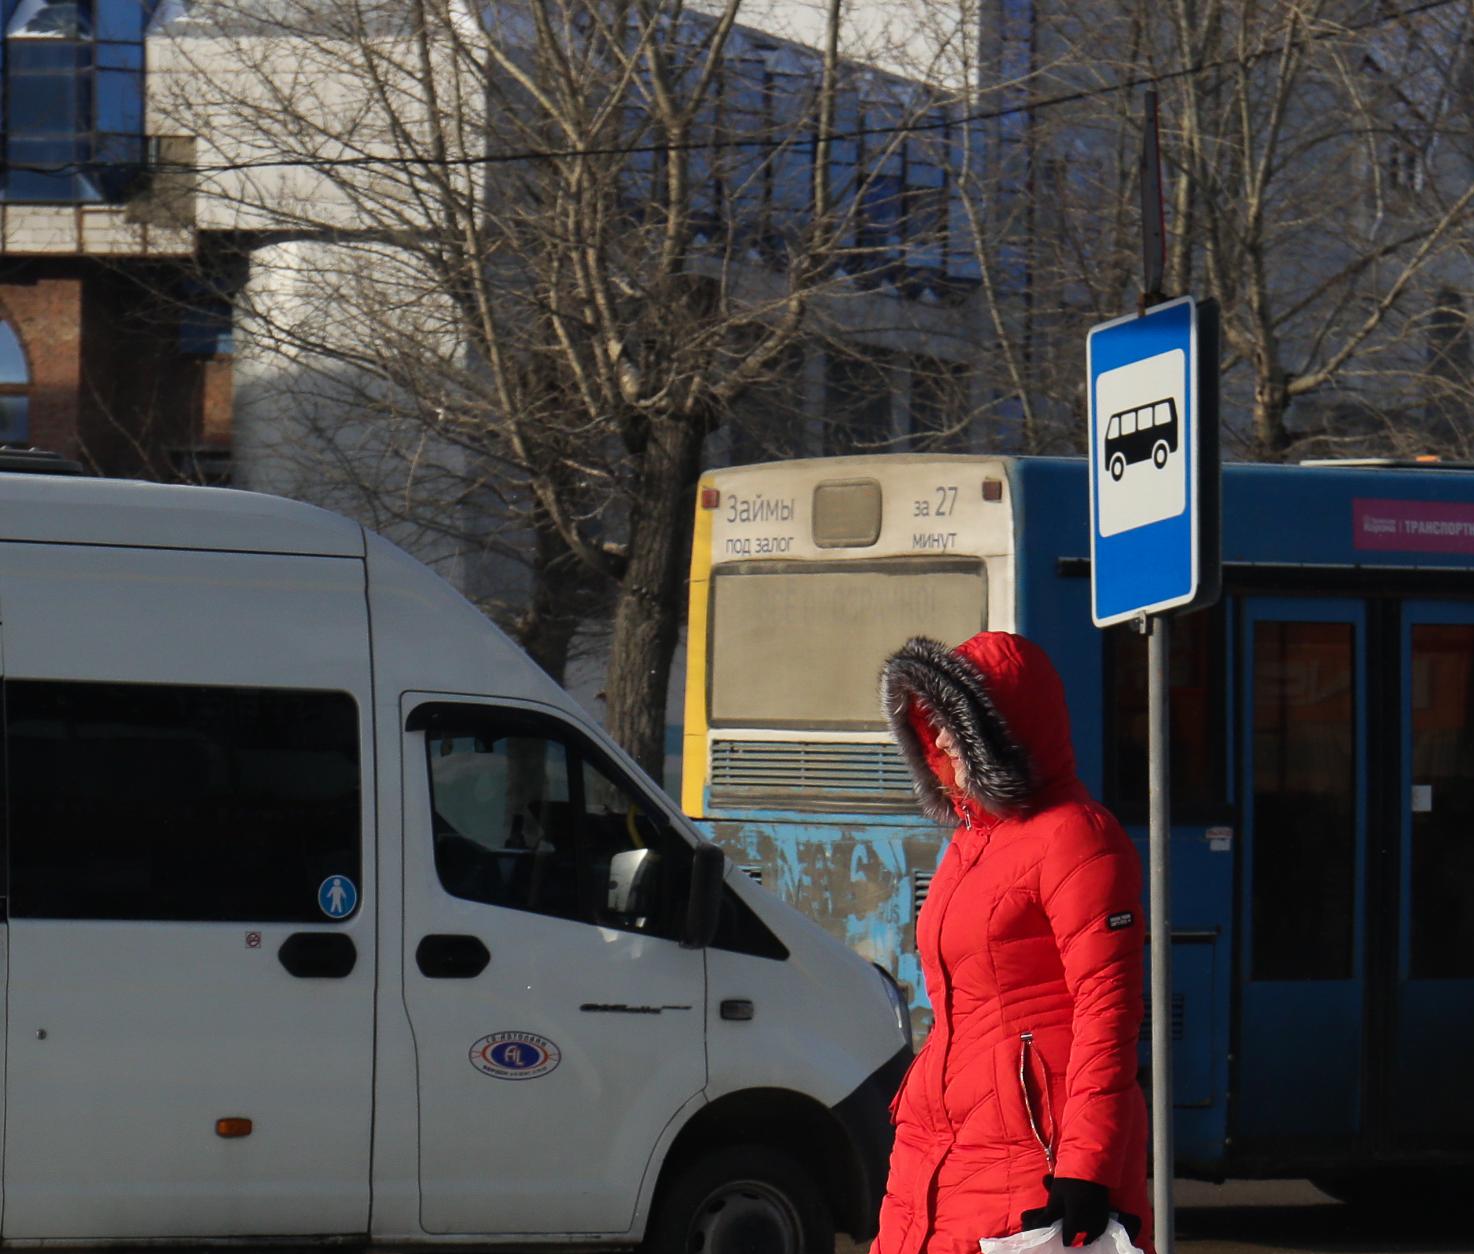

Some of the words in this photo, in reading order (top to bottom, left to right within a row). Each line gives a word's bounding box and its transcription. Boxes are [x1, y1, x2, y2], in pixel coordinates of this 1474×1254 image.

[726, 495, 795, 523] Займы
[912, 499, 931, 518] за
[934, 486, 959, 517] 27
[725, 537, 752, 554] под
[754, 536, 794, 553] залог
[912, 531, 957, 554] минут
